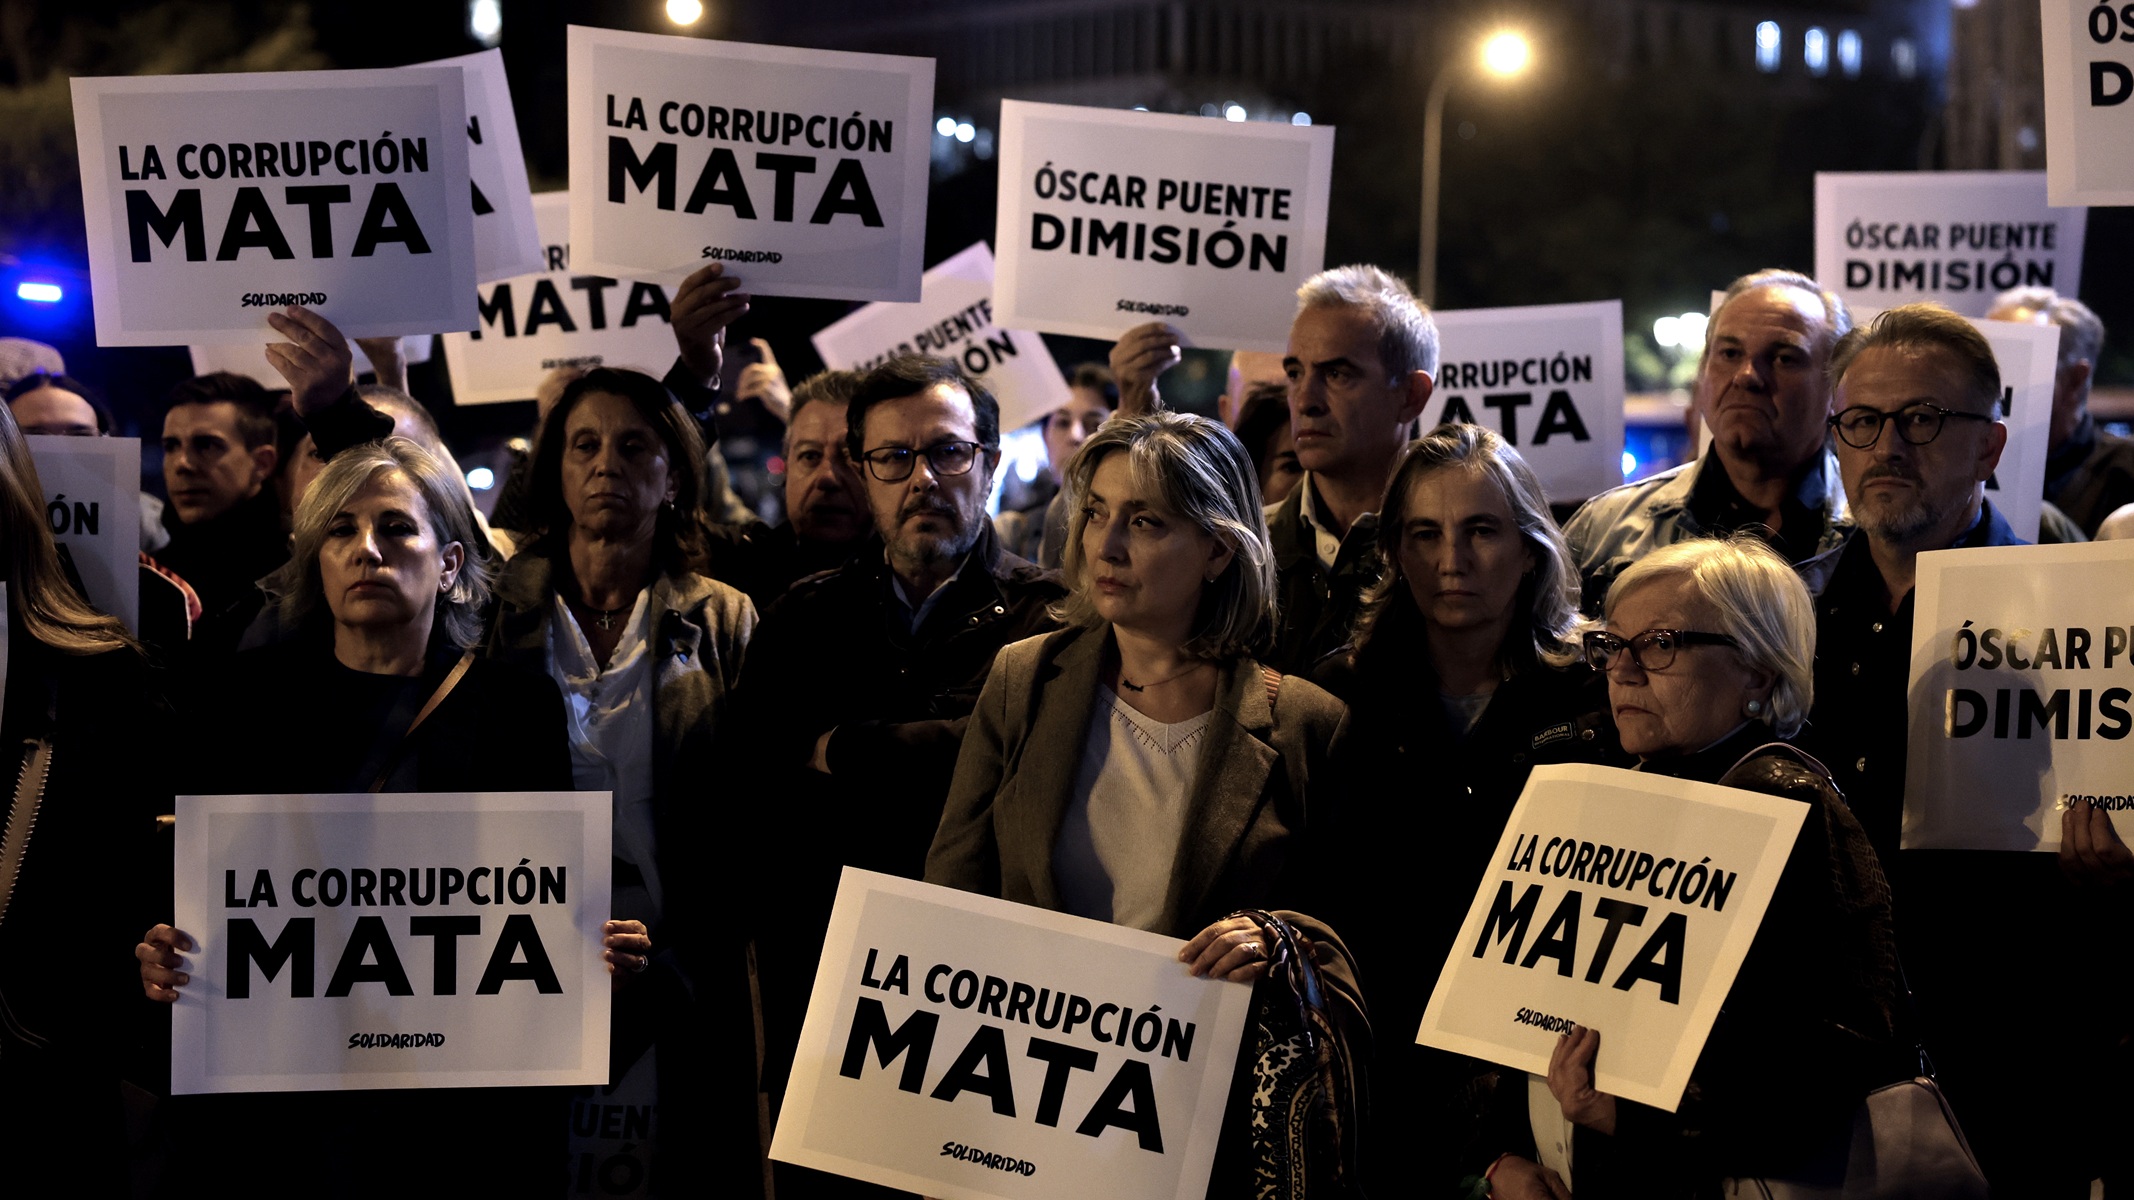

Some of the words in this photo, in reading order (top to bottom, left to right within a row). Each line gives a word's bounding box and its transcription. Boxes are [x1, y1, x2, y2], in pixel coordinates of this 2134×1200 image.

[607, 94, 648, 131] LA
[660, 102, 892, 153] CORRUPCIÓN
[119, 145, 167, 180] LA
[177, 131, 429, 179] CORRUPCIÓN
[609, 136, 884, 228] MATA
[1035, 162, 1147, 208] ÓSCAR
[1158, 179, 1291, 221] PUENTE
[125, 183, 432, 262] MATA
[1032, 213, 1288, 273] DIMISIÓN
[1846, 221, 1940, 250] ÓSCAR
[1950, 222, 2057, 250] PUENTE
[702, 246, 782, 264] SOLIDARIDAD
[1846, 251, 2056, 291] DIMISIÓN
[242, 292, 327, 307] SOLIDARIDAD
[1435, 352, 1592, 389] RRUPCIÓN
[1411, 388, 1592, 447] ATA
[1952, 619, 2091, 671] ÓSCAR
[1944, 687, 2133, 741] DIMIS
[226, 869, 278, 908] LA
[292, 858, 566, 907] CORRUPCIÓN
[1507, 834, 1536, 872] LA
[1540, 837, 1737, 912] CORRUPCIÓN
[226, 915, 563, 999] MATA
[1473, 880, 1687, 1005] MATA
[861, 948, 908, 996] LA
[925, 964, 1196, 1062] CORRUPCIÓN
[348, 1033, 445, 1049] SOLIDARIDAD
[840, 997, 1164, 1154] MATA
[940, 1142, 1035, 1176] SOLIDARIDAD
